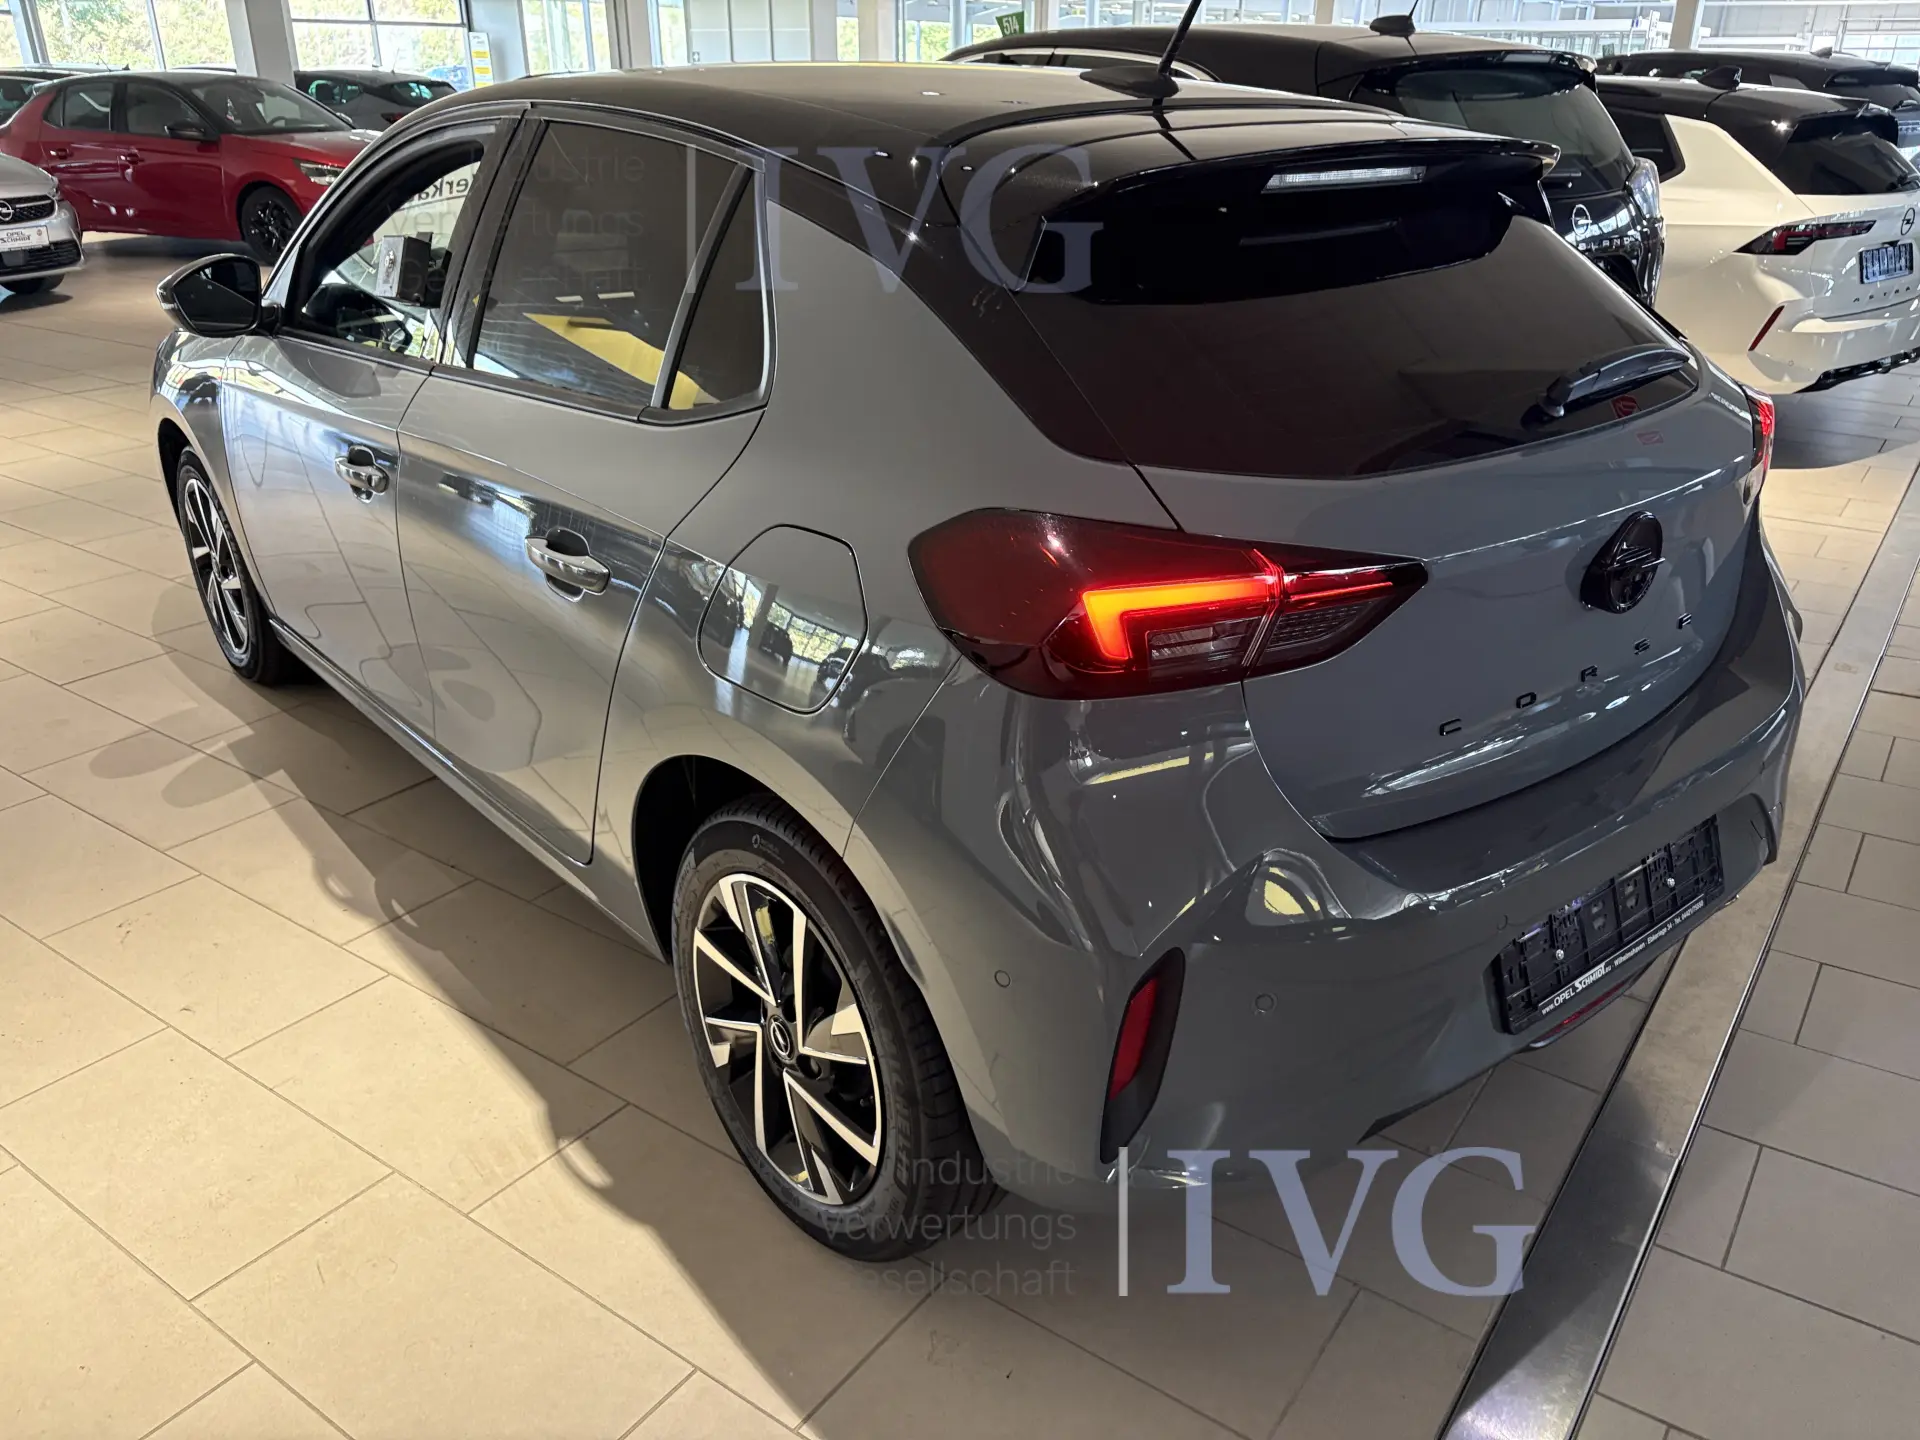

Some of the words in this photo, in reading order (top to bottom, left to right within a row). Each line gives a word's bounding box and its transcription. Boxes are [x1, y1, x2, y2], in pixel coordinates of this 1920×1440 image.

[1002, 15, 1021, 36] 514
[1, 234, 31, 244] SCHMIDT
[1853, 286, 1911, 303] ASTRA
[1438, 612, 1692, 737] CORSA
